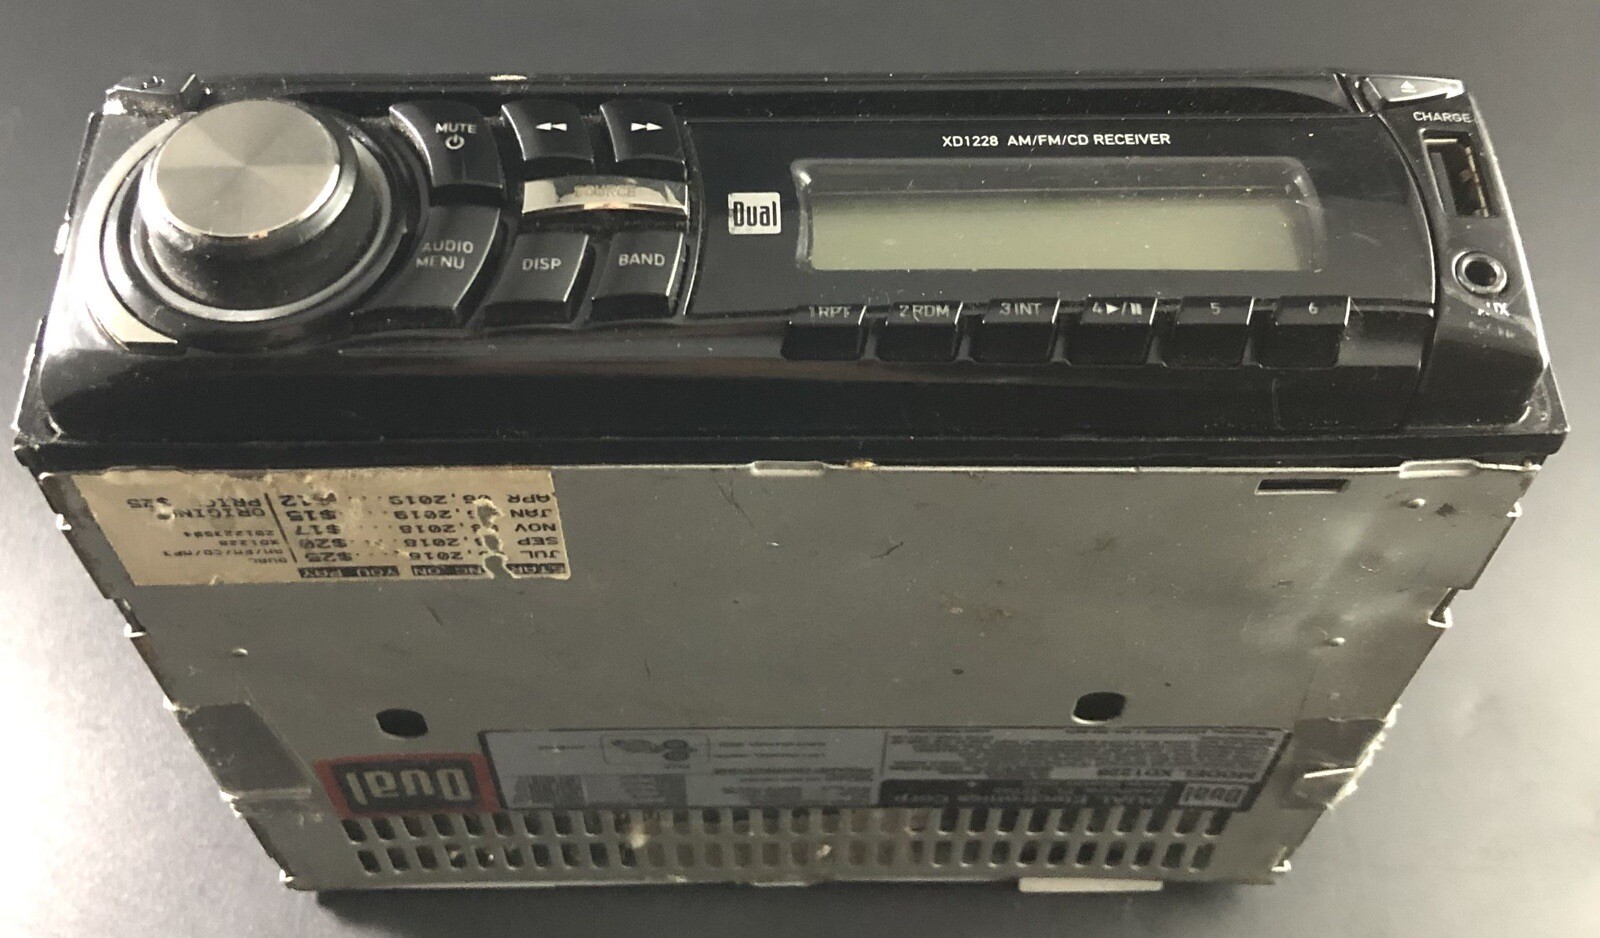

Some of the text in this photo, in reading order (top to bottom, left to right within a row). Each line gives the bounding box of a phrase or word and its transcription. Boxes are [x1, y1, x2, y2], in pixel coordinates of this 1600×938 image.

[1413, 110, 1473, 124] CHARGE
[435, 122, 477, 135] MUTE
[942, 133, 1171, 148] XD1228 AM/FM/CD RECEIVER
[733, 201, 778, 228] Dual
[422, 239, 474, 255] AUDIO
[415, 255, 466, 271] MENU
[522, 257, 562, 271] DISP
[618, 253, 666, 268] BAND
[912, 304, 950, 320] RDM
[1014, 302, 1042, 315] INT
[1211, 302, 1221, 315] 5
[1308, 302, 1318, 315] 6
[507, 494, 551, 504] APR
[285, 509, 337, 522] $15
[509, 508, 553, 518] JAN
[295, 524, 341, 536] $17
[514, 522, 557, 532] NOV
[517, 536, 559, 546] SEP
[520, 549, 560, 559] JUL
[345, 768, 472, 805] Dual
